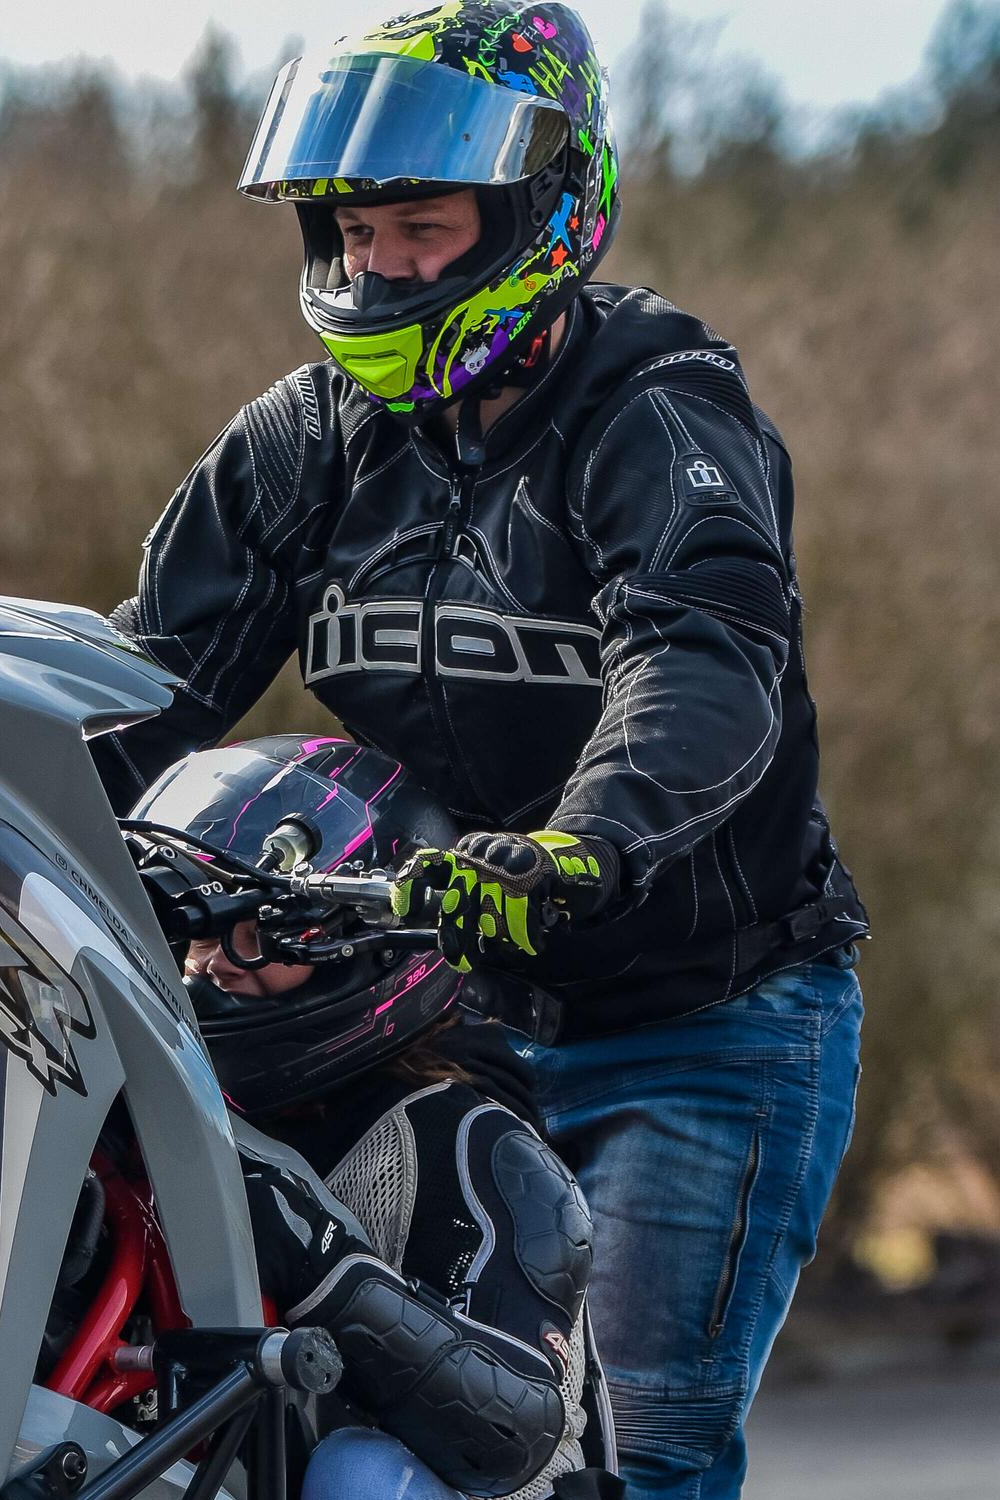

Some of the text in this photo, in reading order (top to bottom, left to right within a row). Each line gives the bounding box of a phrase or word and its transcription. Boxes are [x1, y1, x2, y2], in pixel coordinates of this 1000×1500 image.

[508, 310, 534, 342] LAZER
[405, 963, 427, 988] 390
[321, 1220, 338, 1254] 4SR
